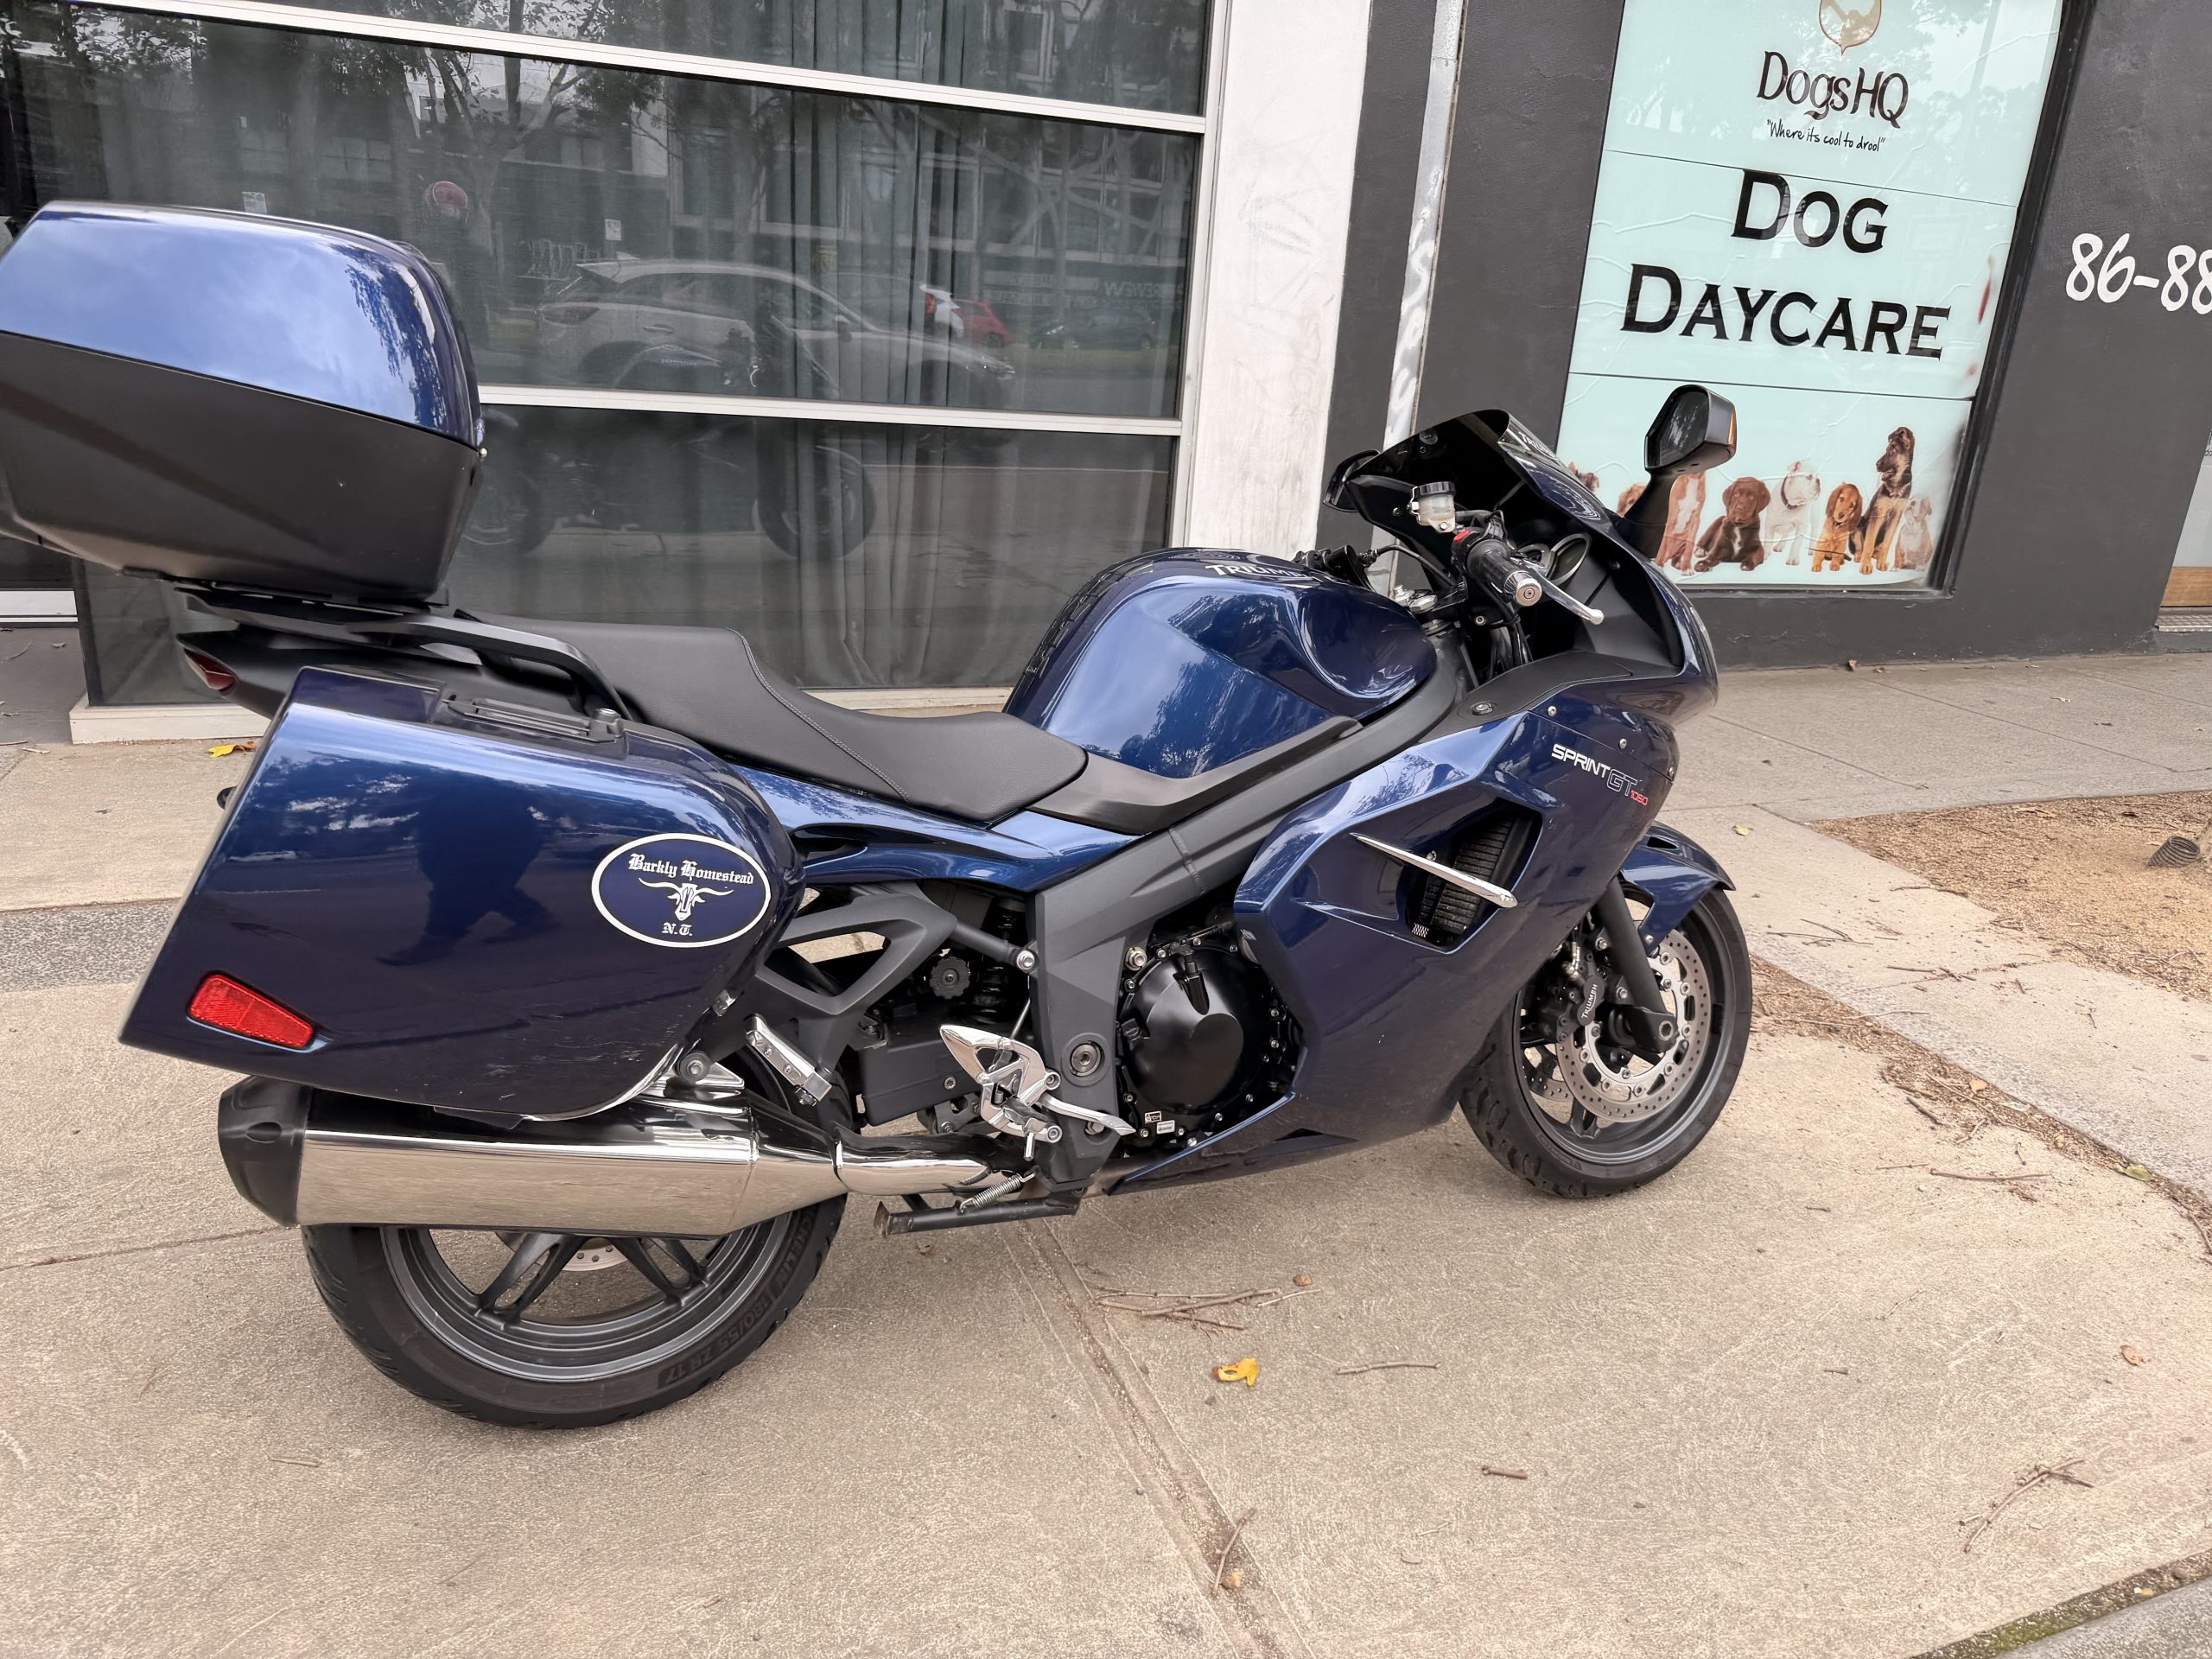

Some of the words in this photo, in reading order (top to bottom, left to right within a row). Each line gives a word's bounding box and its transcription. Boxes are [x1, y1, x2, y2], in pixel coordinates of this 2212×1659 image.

[1757, 51, 1909, 128] DogsHQ
[1823, 131, 1842, 146] cool
[1843, 132, 1853, 148] to
[2066, 233, 2212, 315] 86-88
[1620, 263, 1952, 360] DAYCARE
[1551, 744, 1611, 778] SPRINT
[1607, 768, 1637, 797] GT
[628, 853, 677, 878] Barkly
[681, 860, 754, 885] Homestead
[661, 922, 693, 937] N.T.
[1581, 983, 1598, 1019] TRIUMPH
